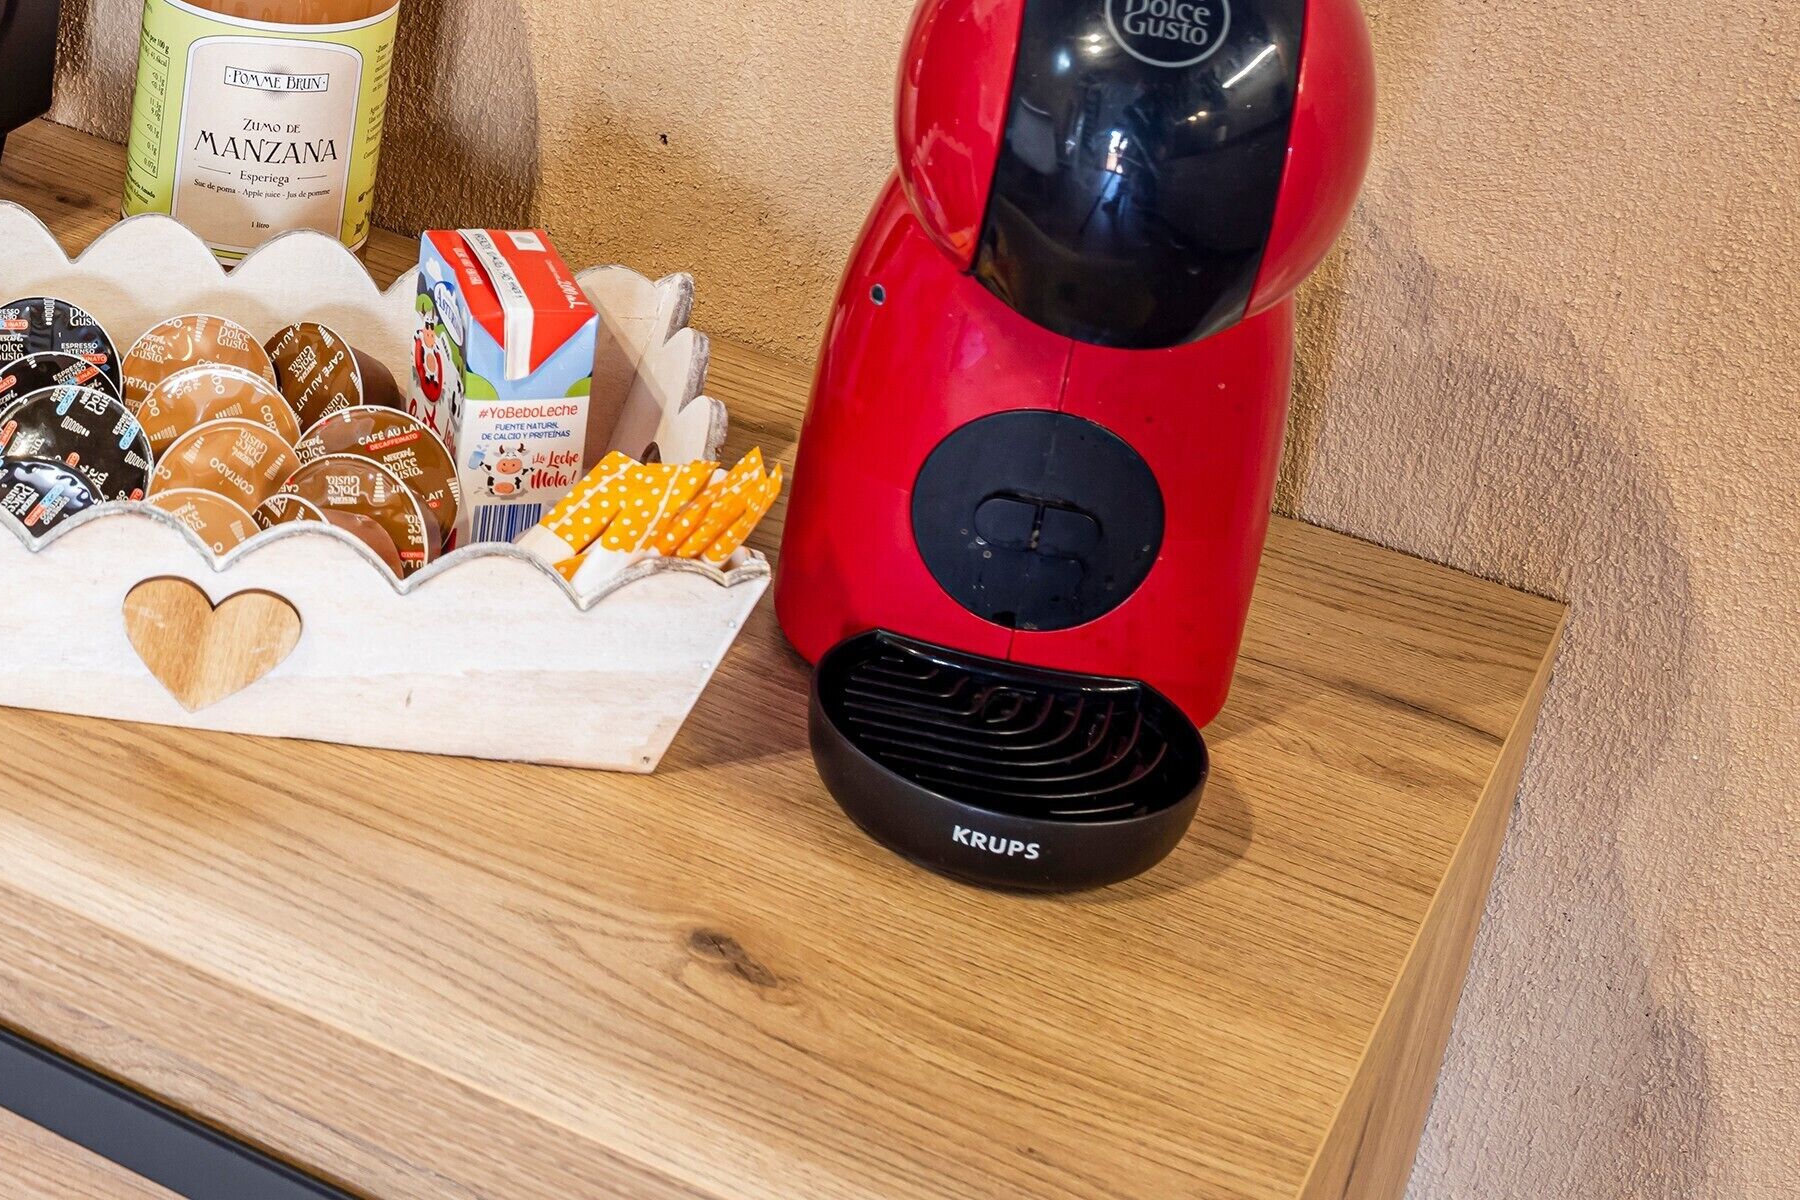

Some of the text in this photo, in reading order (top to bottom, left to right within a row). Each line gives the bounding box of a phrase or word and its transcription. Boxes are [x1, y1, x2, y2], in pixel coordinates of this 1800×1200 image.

[1123, 13, 1208, 46] Gusto
[232, 70, 322, 90] POMME BRUN
[242, 118, 301, 133] ZUMO DE
[194, 130, 338, 164] MANZANA
[240, 170, 290, 187] Esperiega
[217, 186, 236, 194] poma
[242, 189, 263, 197] Apple
[286, 191, 297, 199] Jus
[308, 189, 330, 198] pomme
[256, 221, 269, 229] litro
[218, 326, 250, 343] Dolce
[217, 337, 249, 352] Gusto
[52, 360, 86, 381] ESPRESSO
[297, 351, 344, 412] CAFÉ AU LAIT
[478, 404, 578, 419] #YoBeboLeche
[481, 433, 491, 441] DE
[493, 432, 521, 440] CALCIO
[529, 429, 571, 438] PROTEÍNAS
[495, 423, 525, 431] FUENTE
[358, 430, 385, 446] CAFÉ
[387, 428, 401, 438] AU
[235, 437, 263, 464] Dolce
[547, 450, 579, 468] Leche
[384, 458, 418, 471] Dolce
[209, 457, 254, 495] CORTADO
[325, 475, 360, 487] Gusto
[327, 484, 360, 497] Dolce
[952, 825, 1040, 860] KRUPS
